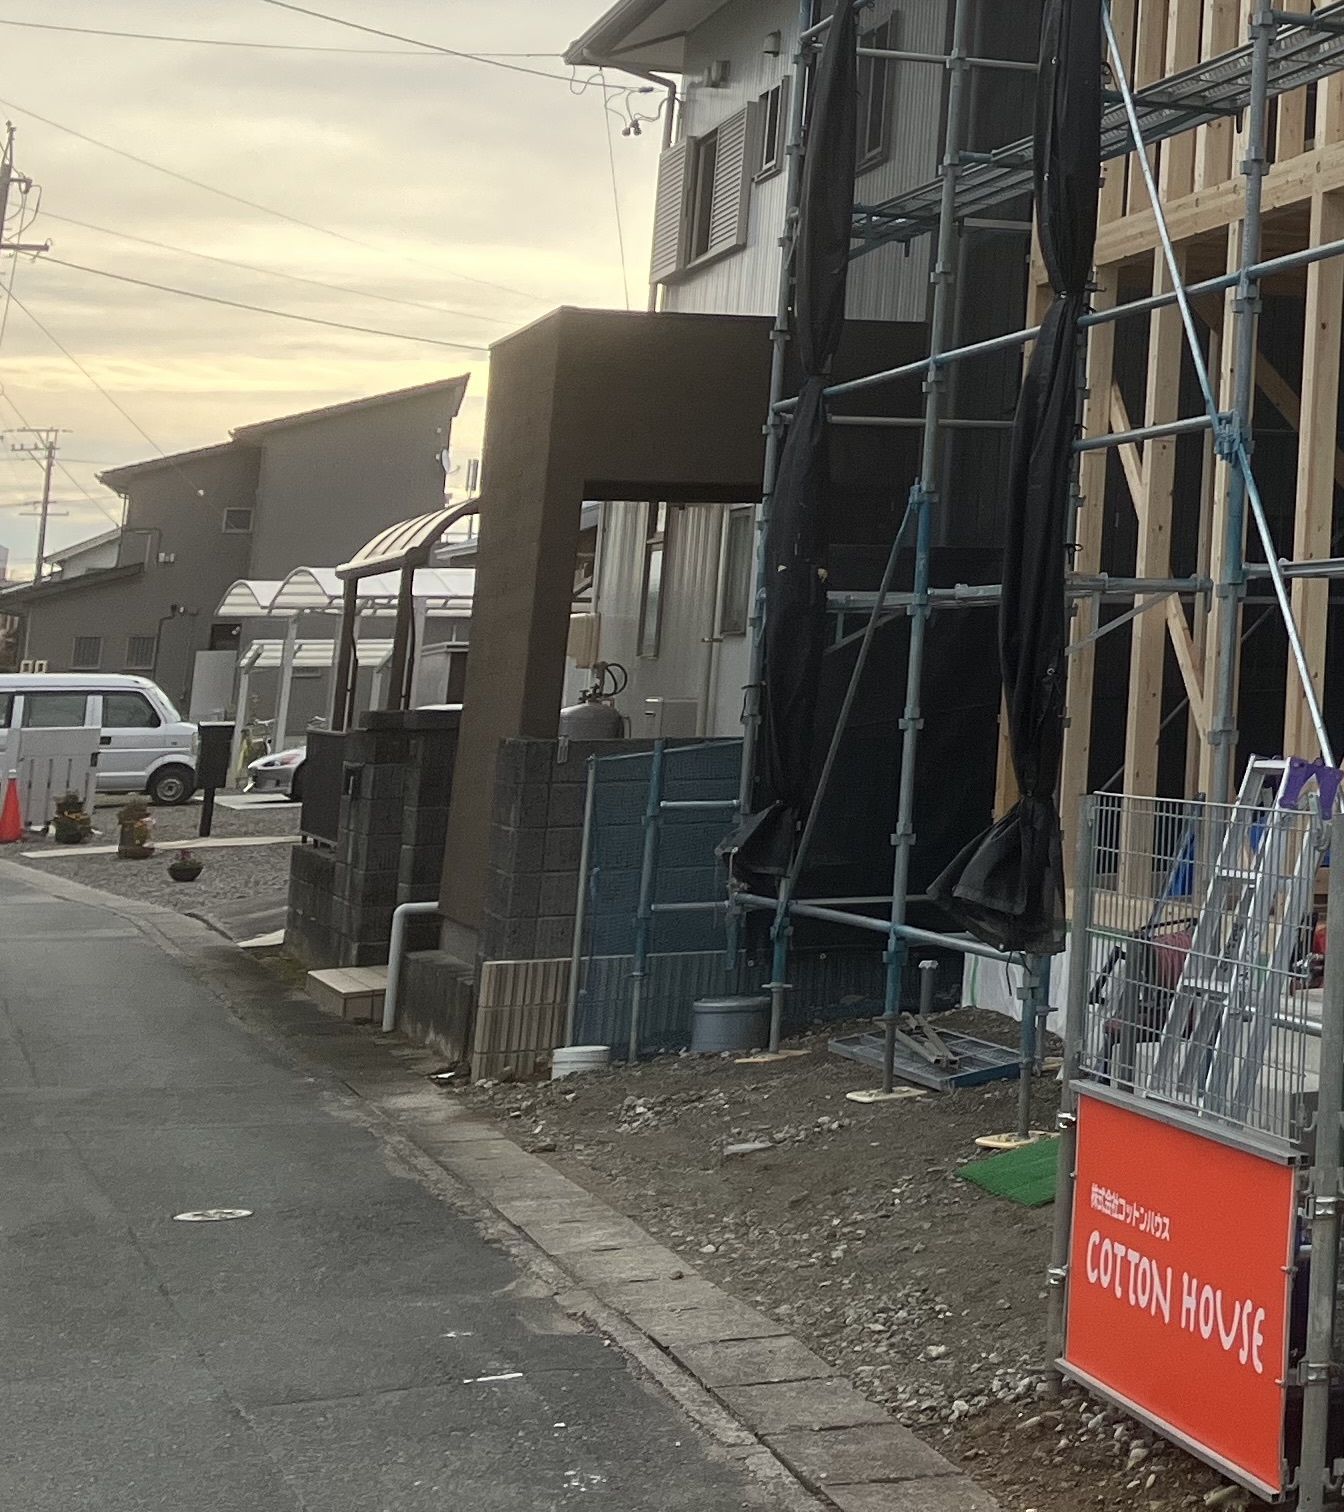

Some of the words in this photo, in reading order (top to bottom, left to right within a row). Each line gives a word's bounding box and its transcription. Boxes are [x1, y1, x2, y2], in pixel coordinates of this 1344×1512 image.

[1090, 1182, 1170, 1242] 株式会社コットンハウス
[1086, 1230, 1173, 1324] COTTON
[1181, 1270, 1265, 1374] HOUSE
